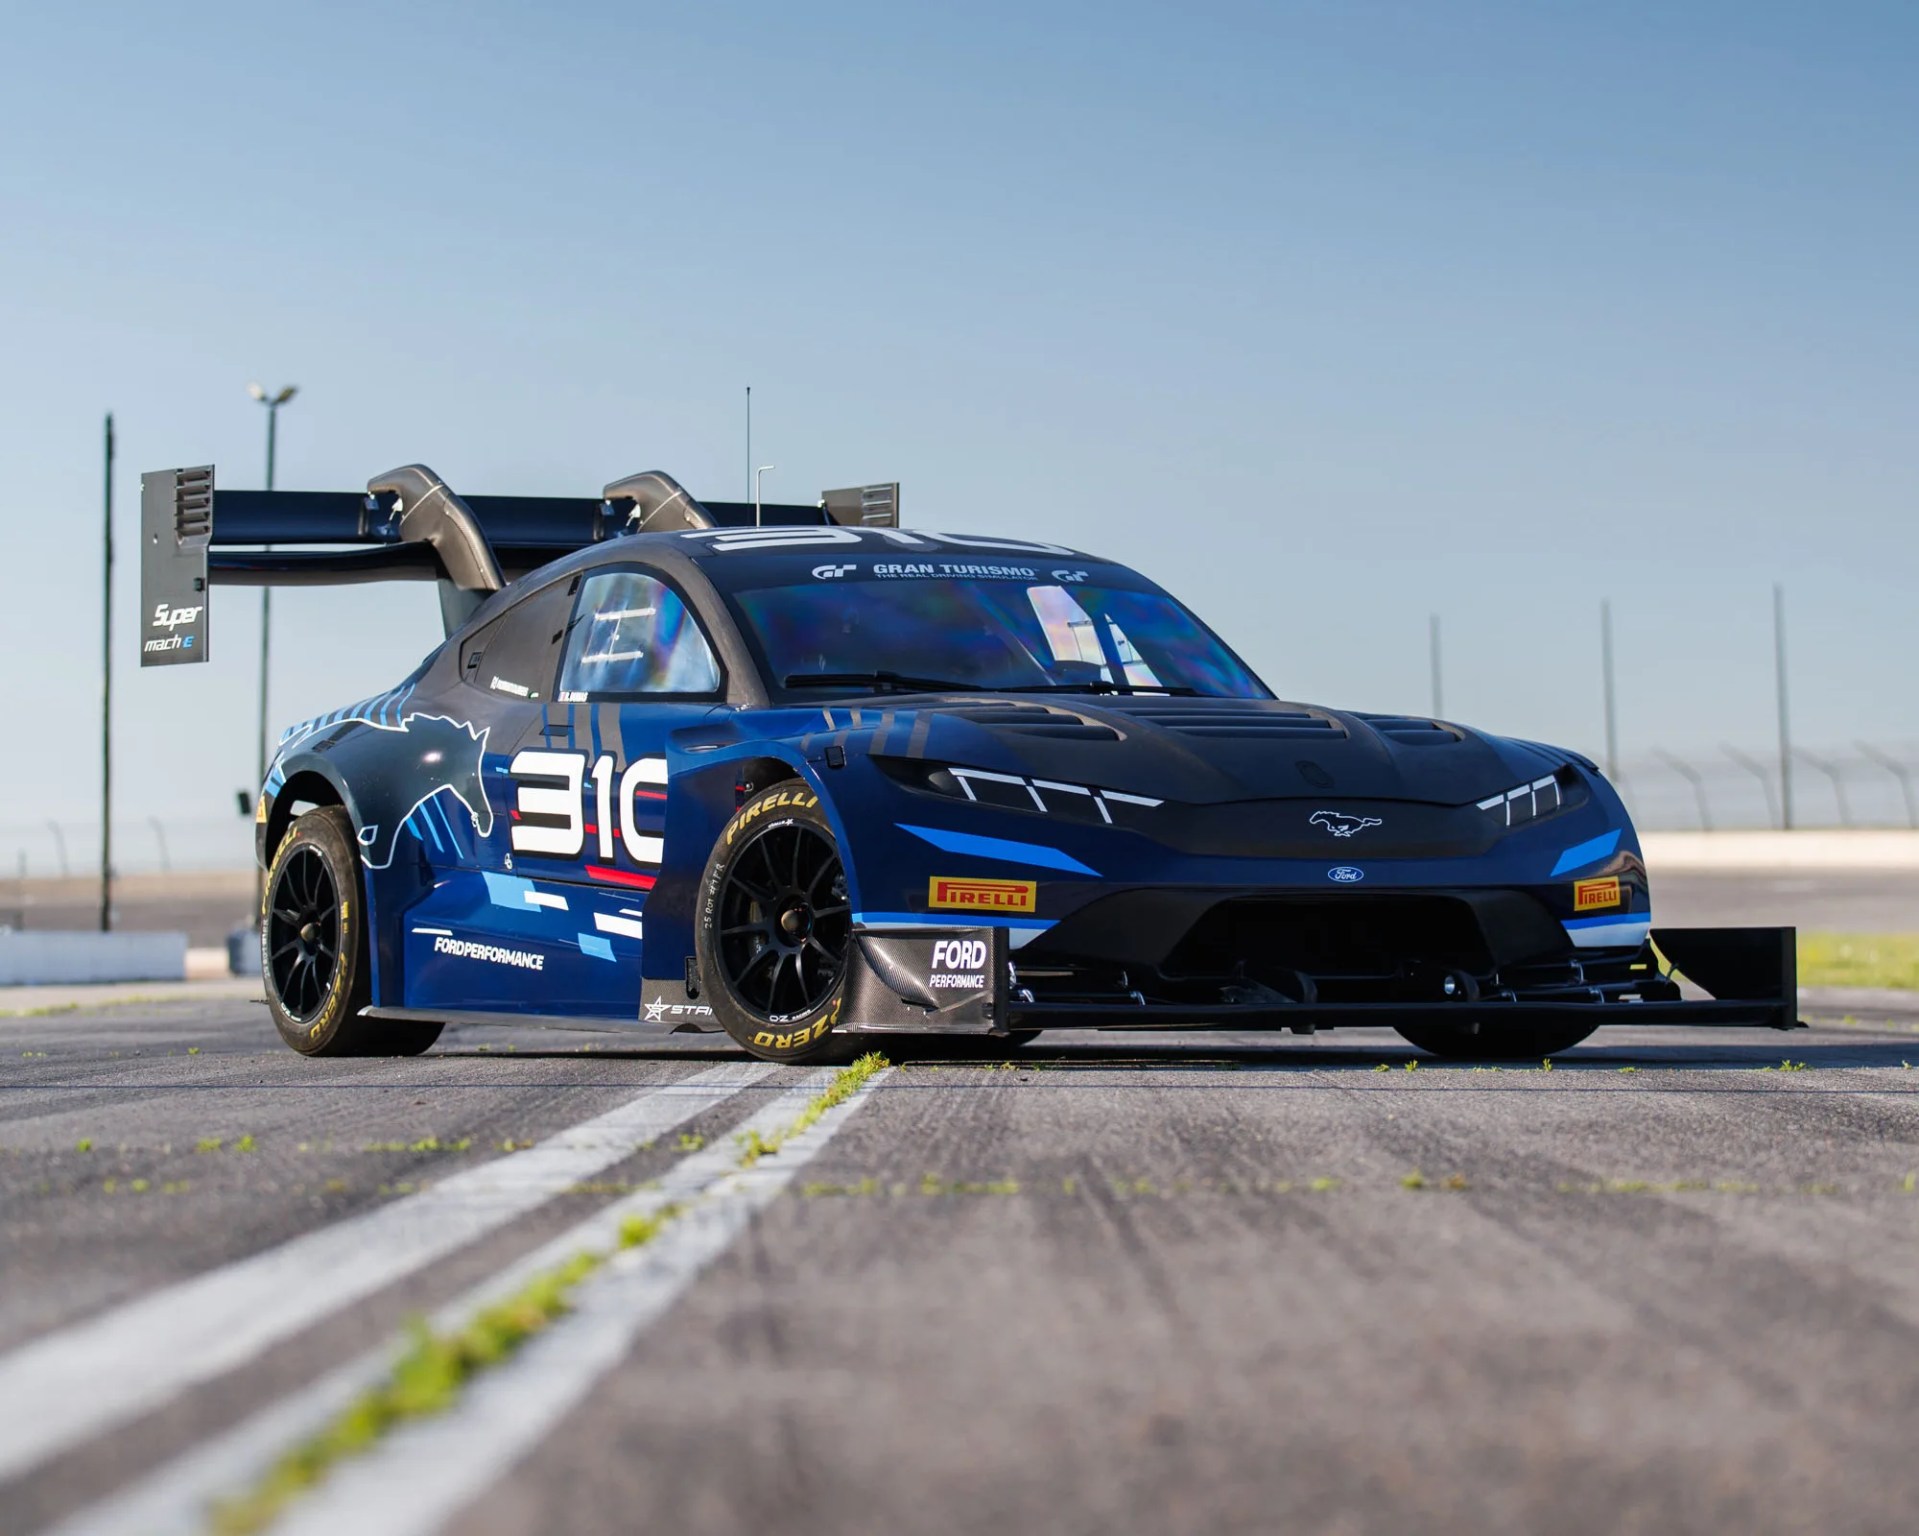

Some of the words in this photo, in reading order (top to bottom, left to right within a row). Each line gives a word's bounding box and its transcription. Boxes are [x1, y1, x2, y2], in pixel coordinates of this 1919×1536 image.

[873, 564, 934, 574] GRAN
[939, 564, 1036, 577] TURISMO
[152, 603, 203, 632] Super
[144, 633, 182, 653] mach
[726, 792, 819, 846] PIRELLI
[937, 881, 1029, 907] PIRELLI
[1578, 881, 1617, 906] PIRELLI
[931, 940, 987, 970] FORD
[929, 974, 986, 989] PERFORMANCE
[753, 1014, 829, 1049] ZERO
